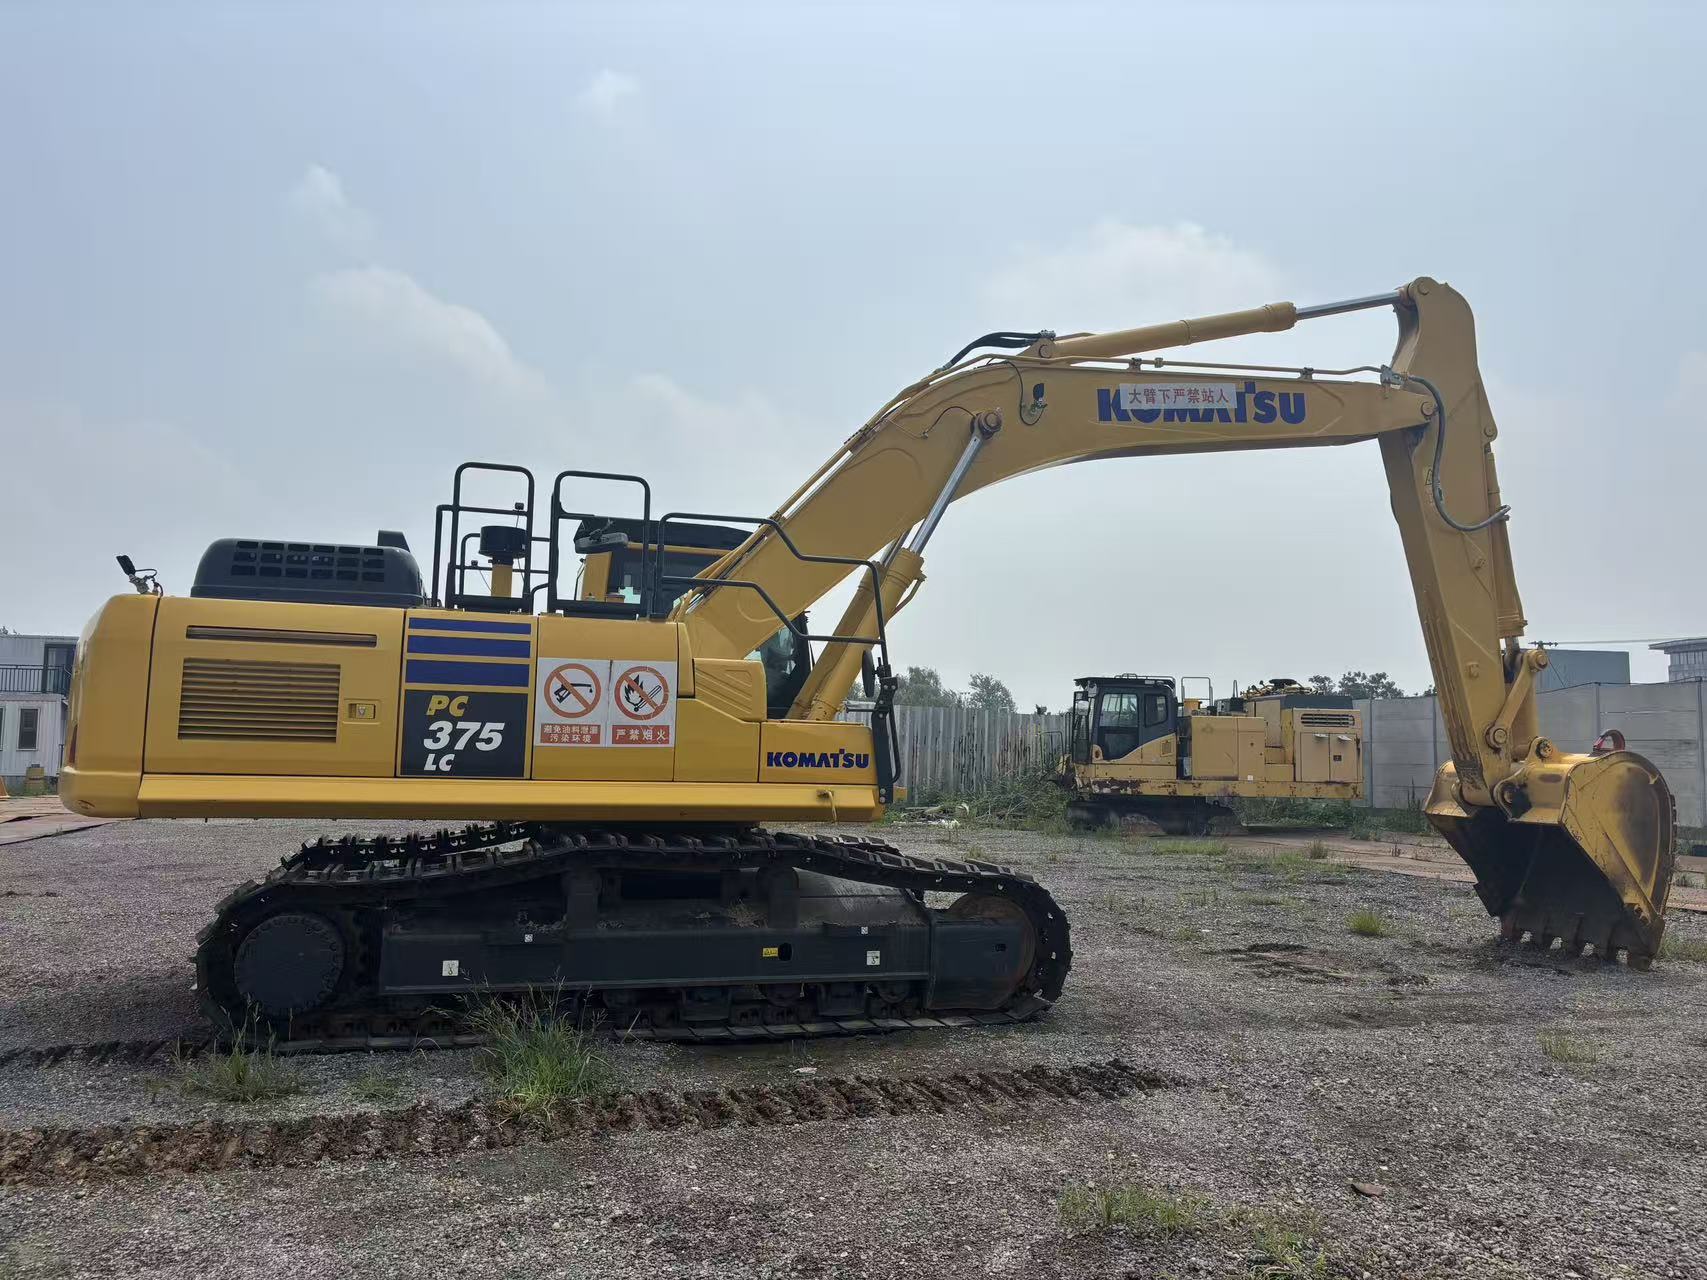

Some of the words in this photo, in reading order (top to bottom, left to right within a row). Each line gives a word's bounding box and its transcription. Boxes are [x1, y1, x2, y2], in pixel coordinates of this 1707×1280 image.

[1128, 387, 1230, 405] 大臂下严禁站人
[425, 694, 469, 717] PC
[423, 720, 506, 752] 375
[615, 729, 666, 742] 严禁烟火
[423, 753, 456, 772] LC
[766, 748, 870, 769] KOMATSU
